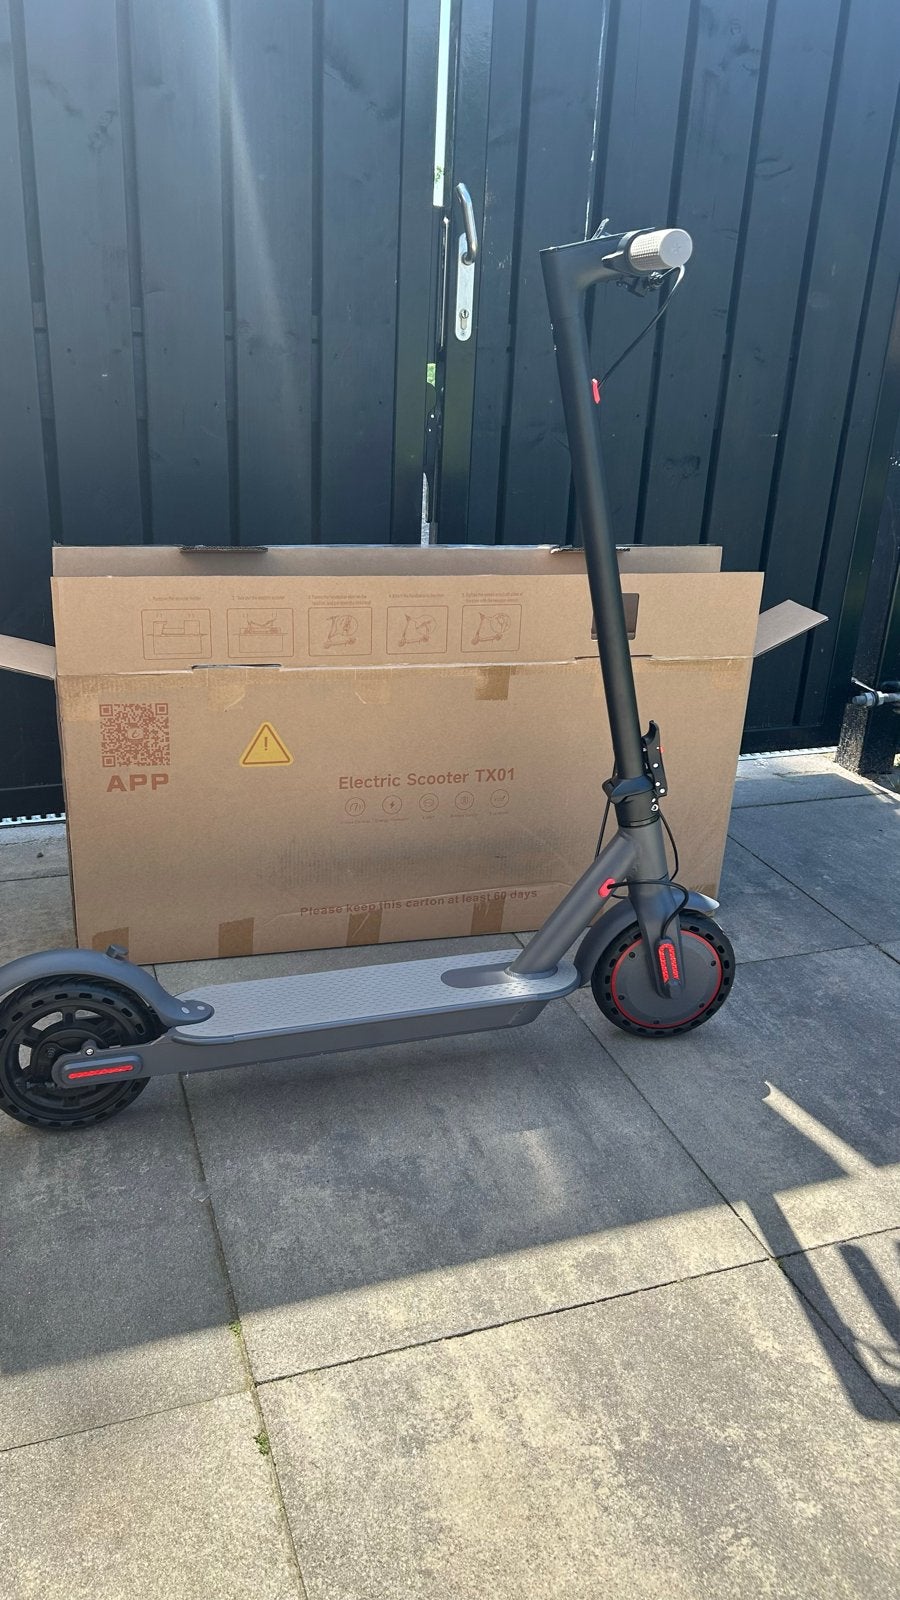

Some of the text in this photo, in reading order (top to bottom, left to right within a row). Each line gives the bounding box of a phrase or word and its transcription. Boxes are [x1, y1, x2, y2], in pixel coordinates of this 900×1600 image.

[106, 773, 169, 792] APP
[338, 767, 515, 790] Electric Scooter TX01
[300, 889, 538, 916] Please keep this carton at least 60 days
